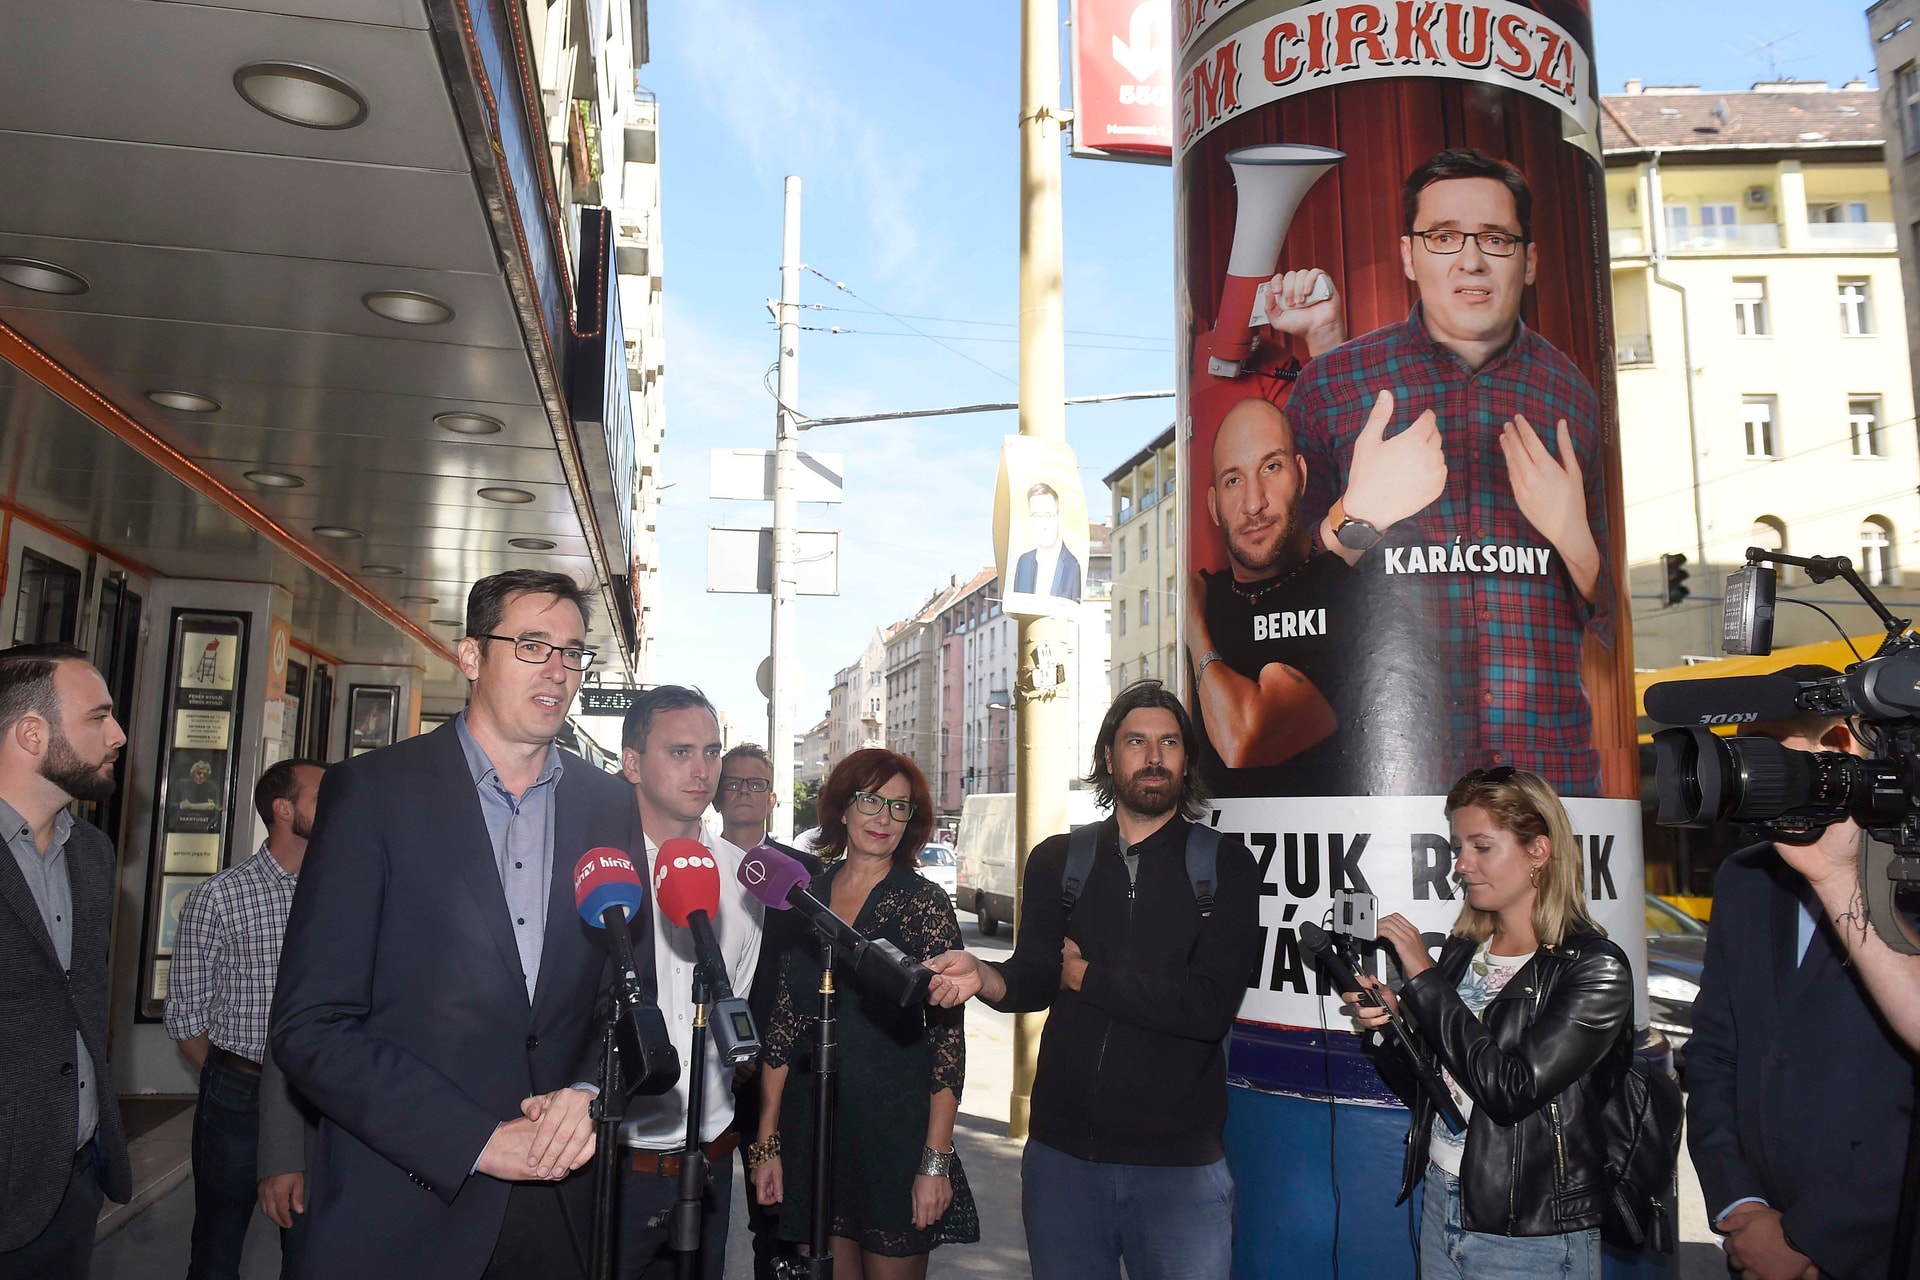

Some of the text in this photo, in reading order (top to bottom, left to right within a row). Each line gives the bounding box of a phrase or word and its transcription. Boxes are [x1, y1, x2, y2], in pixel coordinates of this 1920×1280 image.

[1262, 0, 1576, 105] CIRKUSZ!
[1385, 535, 1551, 576] KARÁCSONY
[1253, 608, 1327, 642] BERKI
